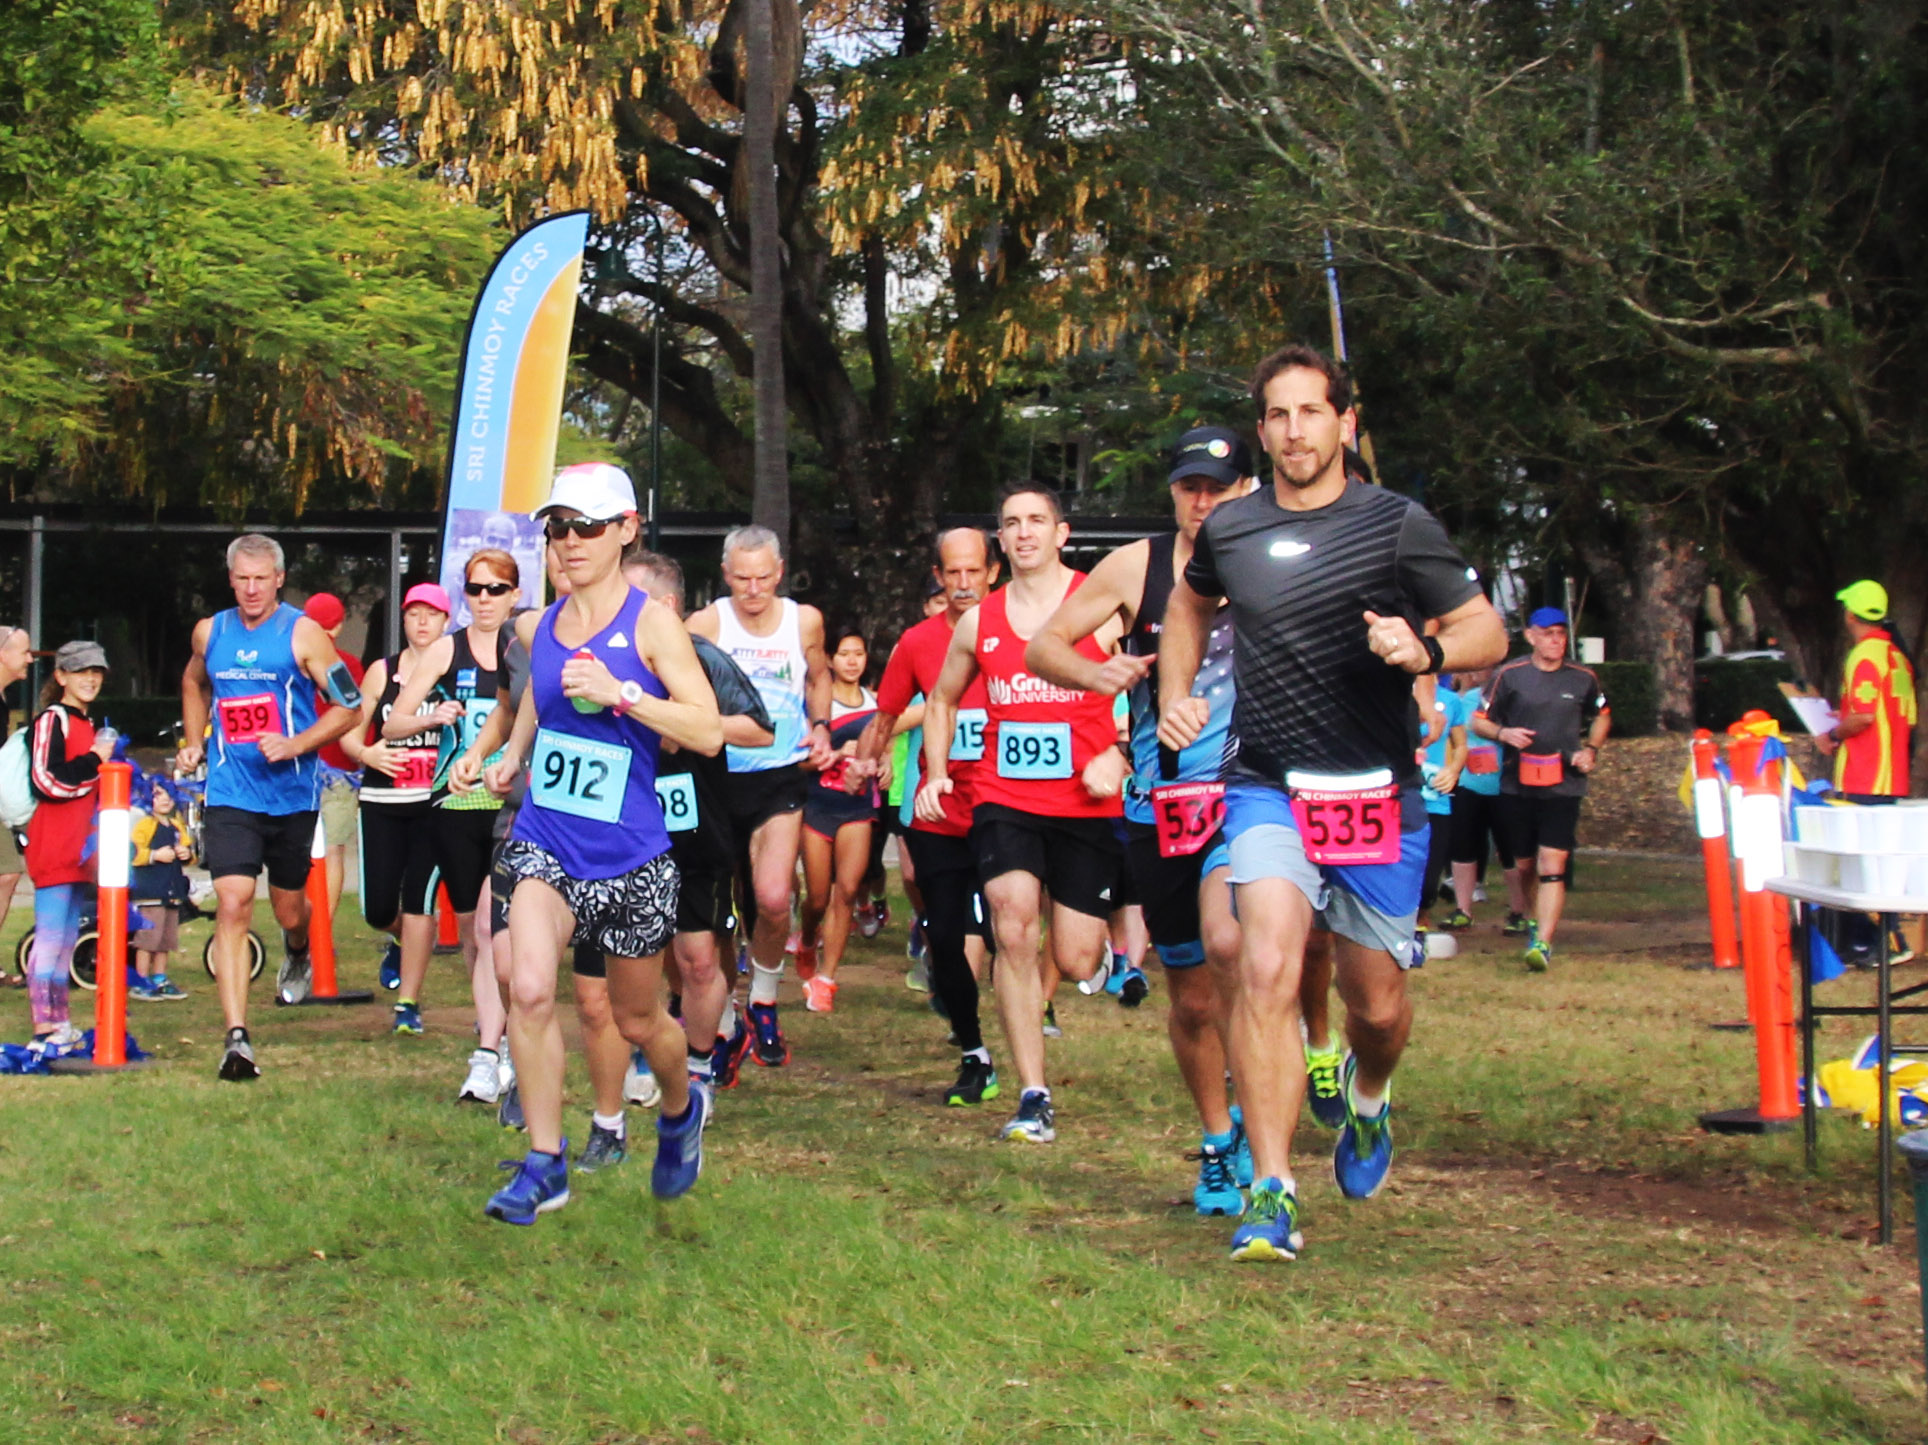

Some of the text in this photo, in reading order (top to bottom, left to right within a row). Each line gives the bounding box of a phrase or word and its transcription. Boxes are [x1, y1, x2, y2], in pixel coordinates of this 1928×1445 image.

[466, 241, 549, 482] SRI CHINMOY RACES
[215, 672, 277, 680] MEDICAL CENTRE
[1012, 690, 1085, 704] UNIVERSITY
[226, 705, 269, 733] 539
[952, 721, 985, 749] 15
[594, 745, 625, 761] RACES
[1005, 736, 1061, 766] 893
[543, 750, 609, 802] 912
[1168, 785, 1207, 797] CHINMOY
[1312, 792, 1360, 802] CHINMOY
[1360, 789, 1393, 799] RACES
[1306, 803, 1384, 846] 535
